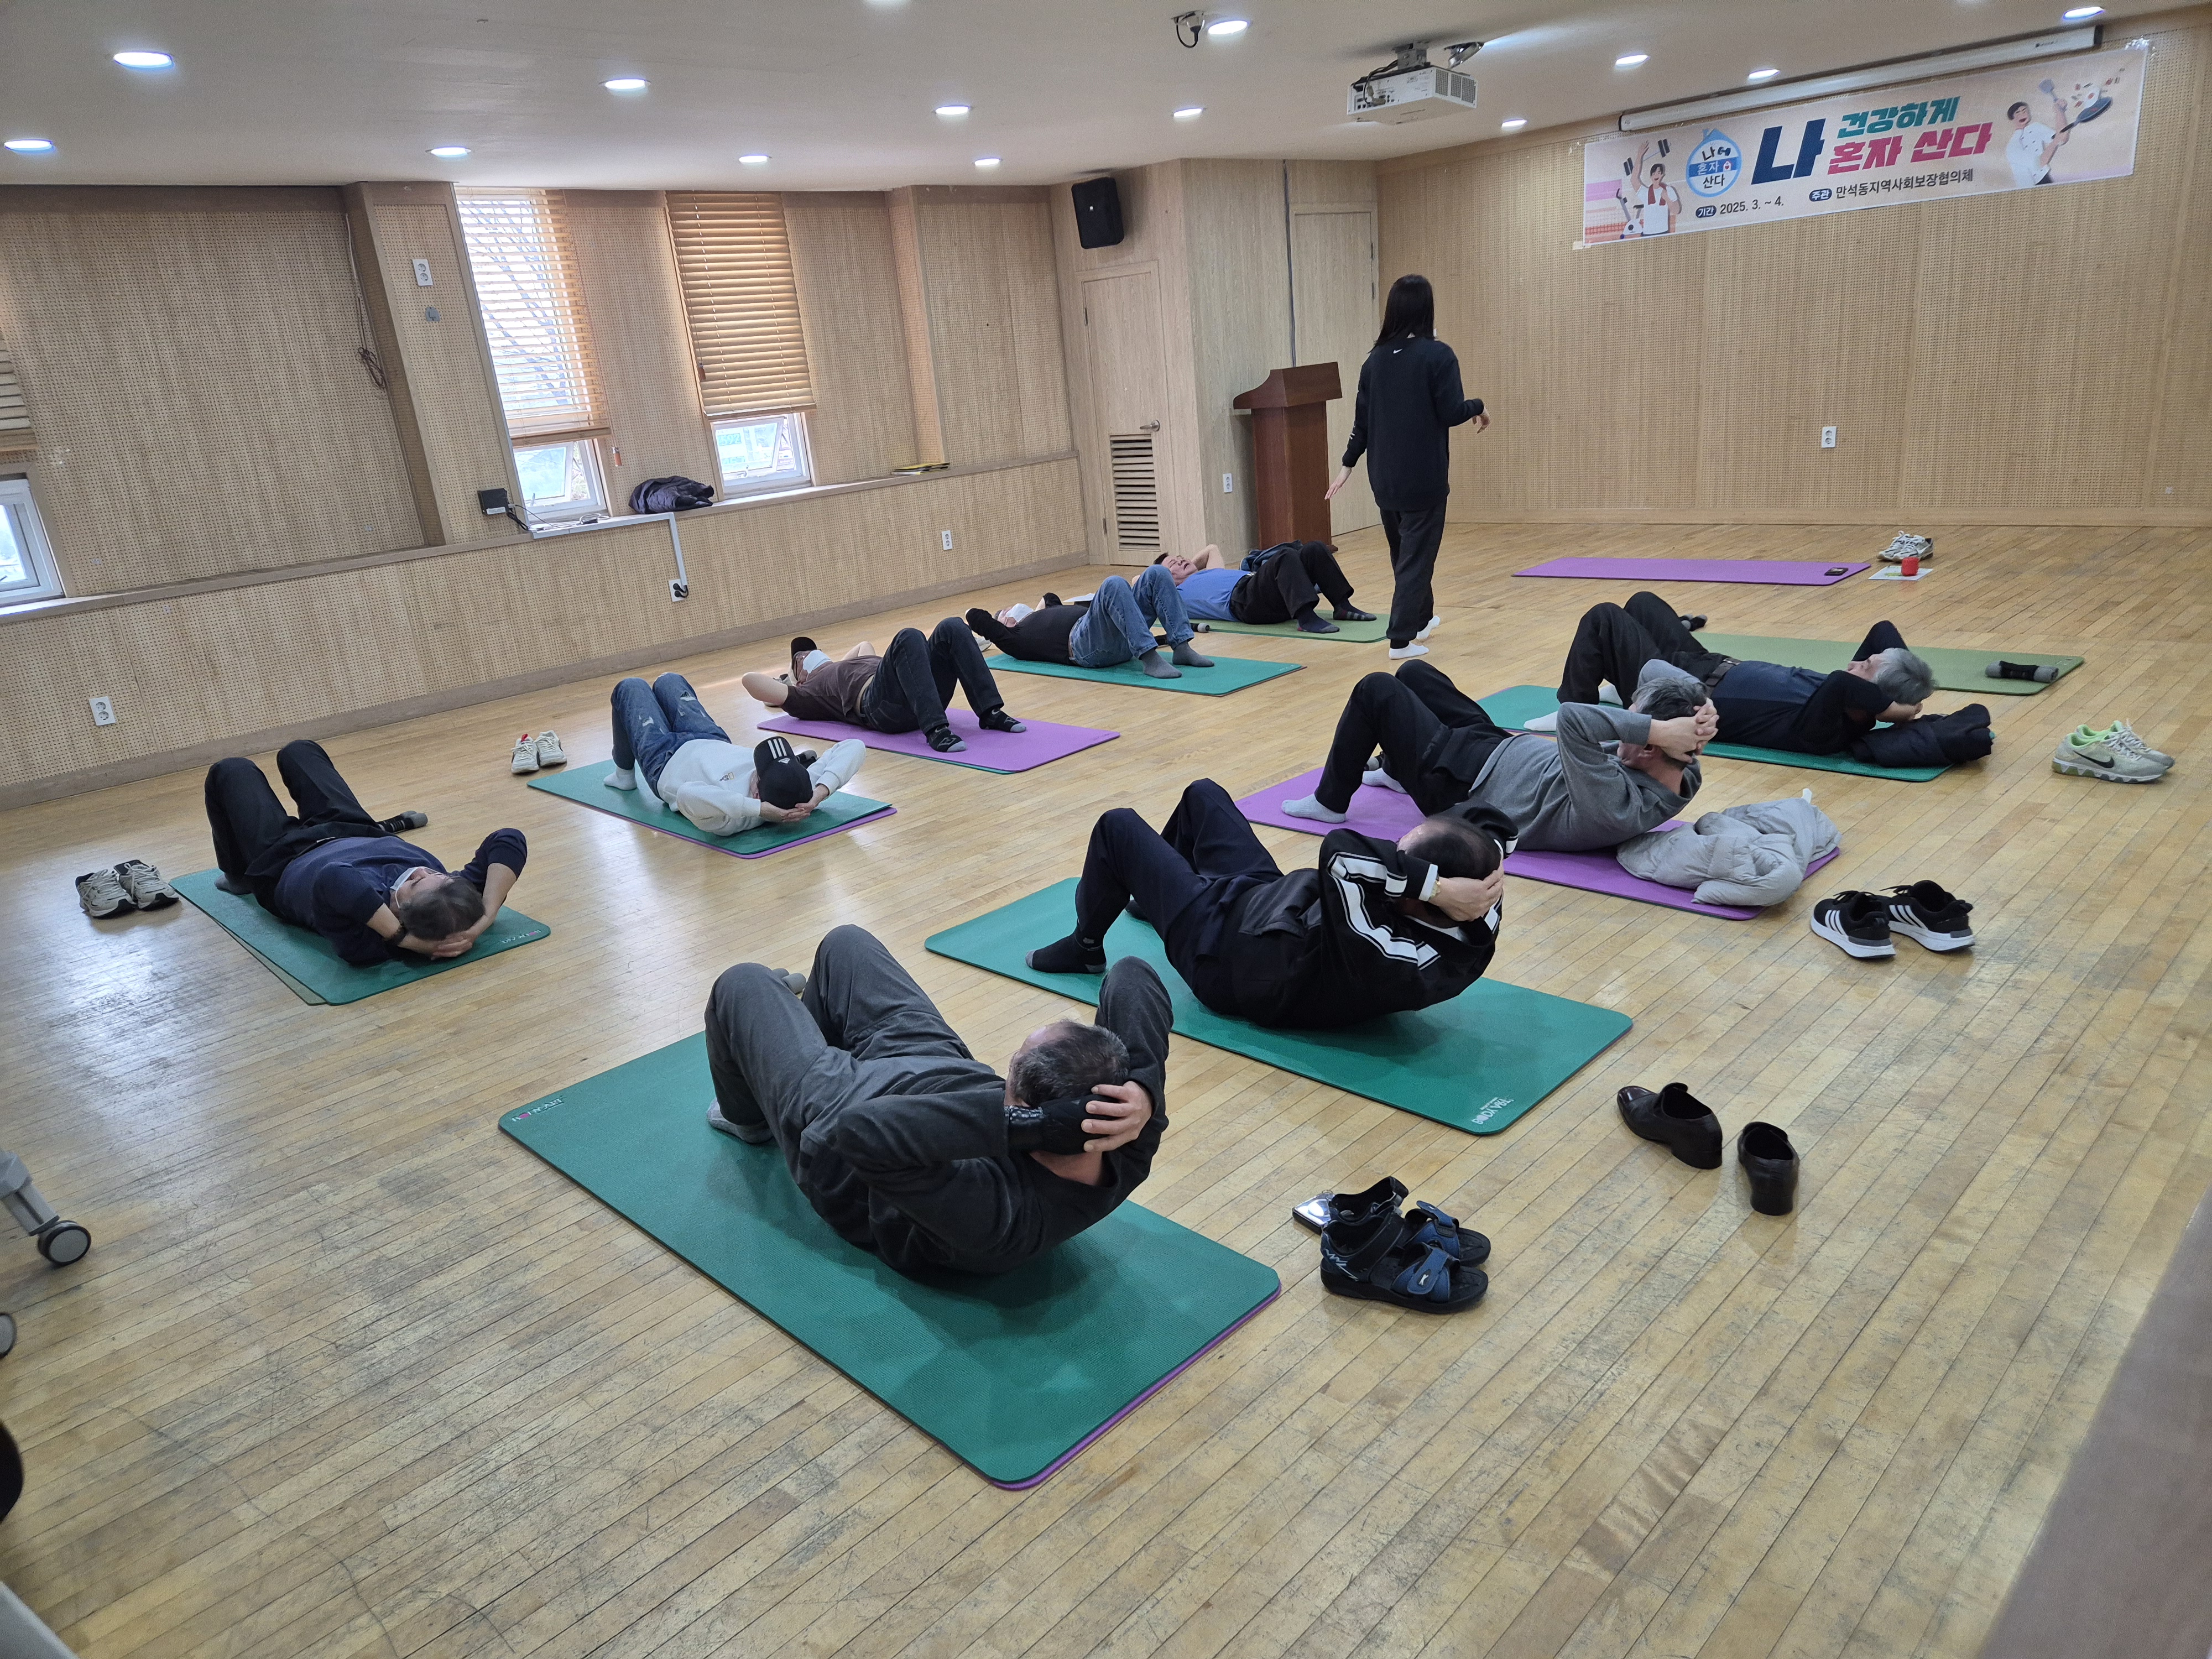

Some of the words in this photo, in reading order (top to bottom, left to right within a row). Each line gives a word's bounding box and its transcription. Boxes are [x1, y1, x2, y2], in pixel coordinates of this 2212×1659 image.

[1837, 96, 1960, 138] 건강하게
[1702, 146, 1715, 161] 나
[1751, 118, 1826, 184] 나
[1827, 135, 1903, 175] 혼자
[1911, 122, 1993, 163] 산다
[1697, 161, 1720, 175] 혼자
[1703, 174, 1725, 189] 산다
[1836, 168, 1973, 199] 만석동지역사회보장협의체
[1811, 189, 1830, 200] 주관
[1698, 206, 1714, 217] 기간
[1720, 201, 1749, 215] 2025.
[1752, 199, 1761, 210] 3.
[1775, 195, 1784, 206] 4.
